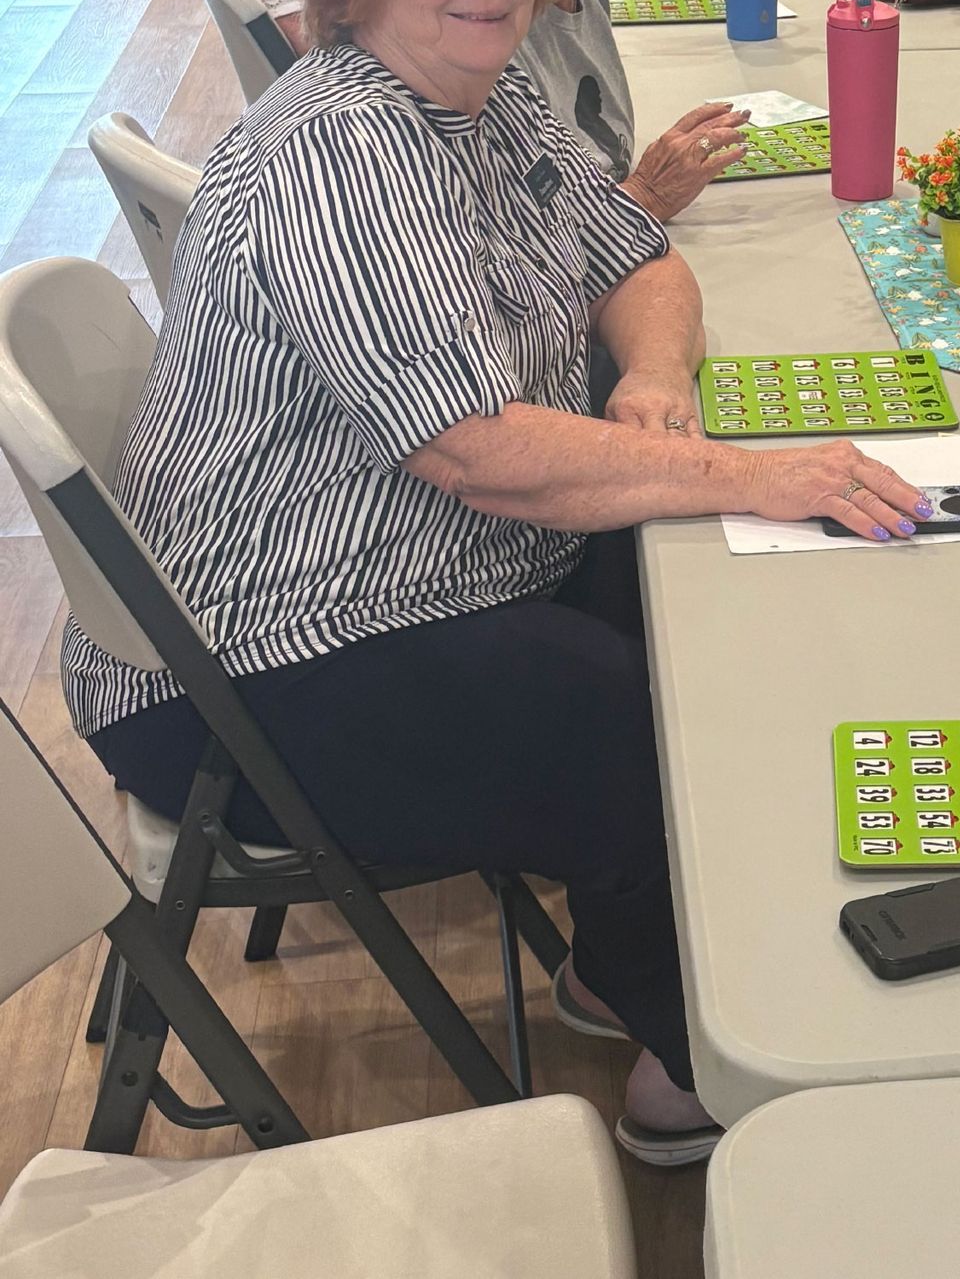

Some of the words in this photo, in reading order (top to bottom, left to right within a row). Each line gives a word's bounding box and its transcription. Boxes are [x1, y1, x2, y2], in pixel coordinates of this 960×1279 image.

[855, 737, 883, 745] 4
[910, 734, 939, 747] 12
[856, 761, 886, 776] 24
[914, 760, 943, 774] 18
[858, 788, 889, 803] 39
[916, 788, 946, 801] 33
[860, 815, 891, 829] 53
[919, 814, 950, 828] 54
[863, 840, 894, 855] 70
[920, 840, 954, 855] 73
